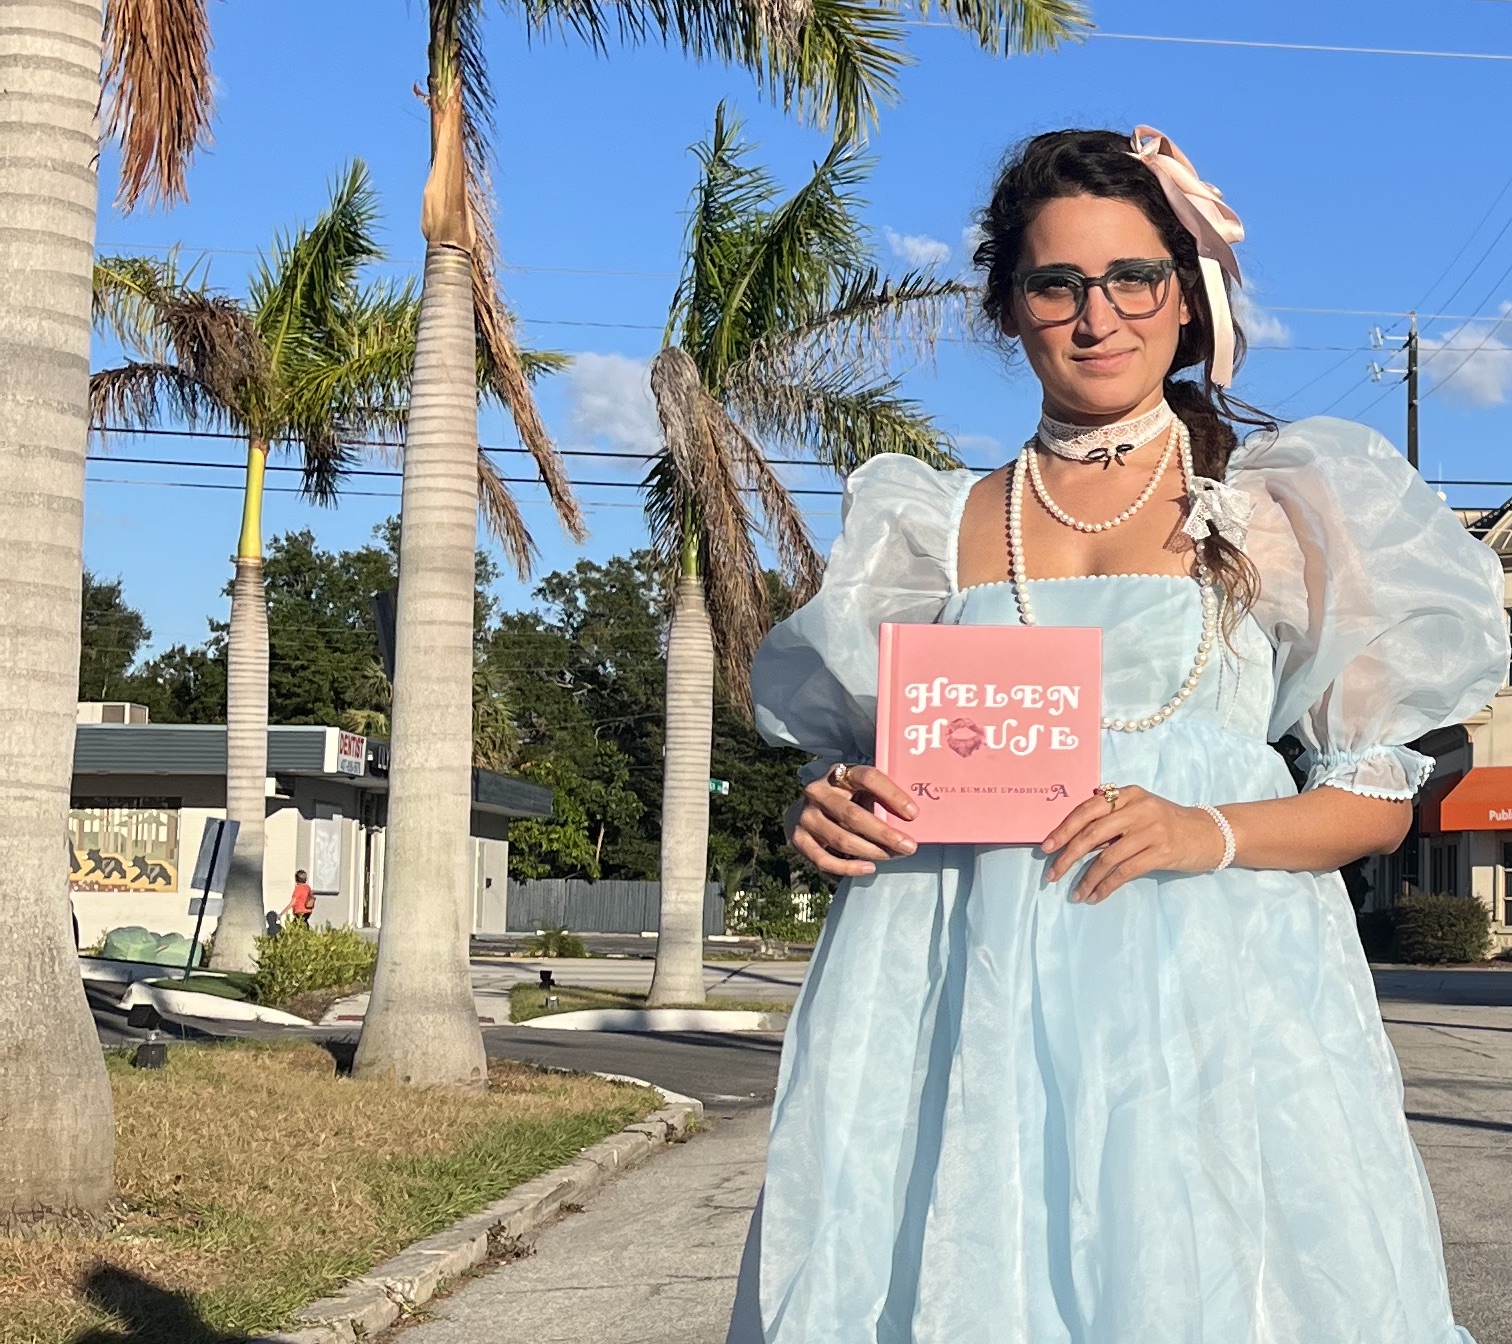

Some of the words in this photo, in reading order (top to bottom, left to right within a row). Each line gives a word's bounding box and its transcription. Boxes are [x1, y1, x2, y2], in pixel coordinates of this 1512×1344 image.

[905, 677, 1081, 716] HELEN
[340, 733, 365, 759] DENTIST
[911, 783, 957, 800] KAYLA
[960, 786, 997, 794] KUMARI
[1000, 784, 1069, 801] UPADHYAYA
